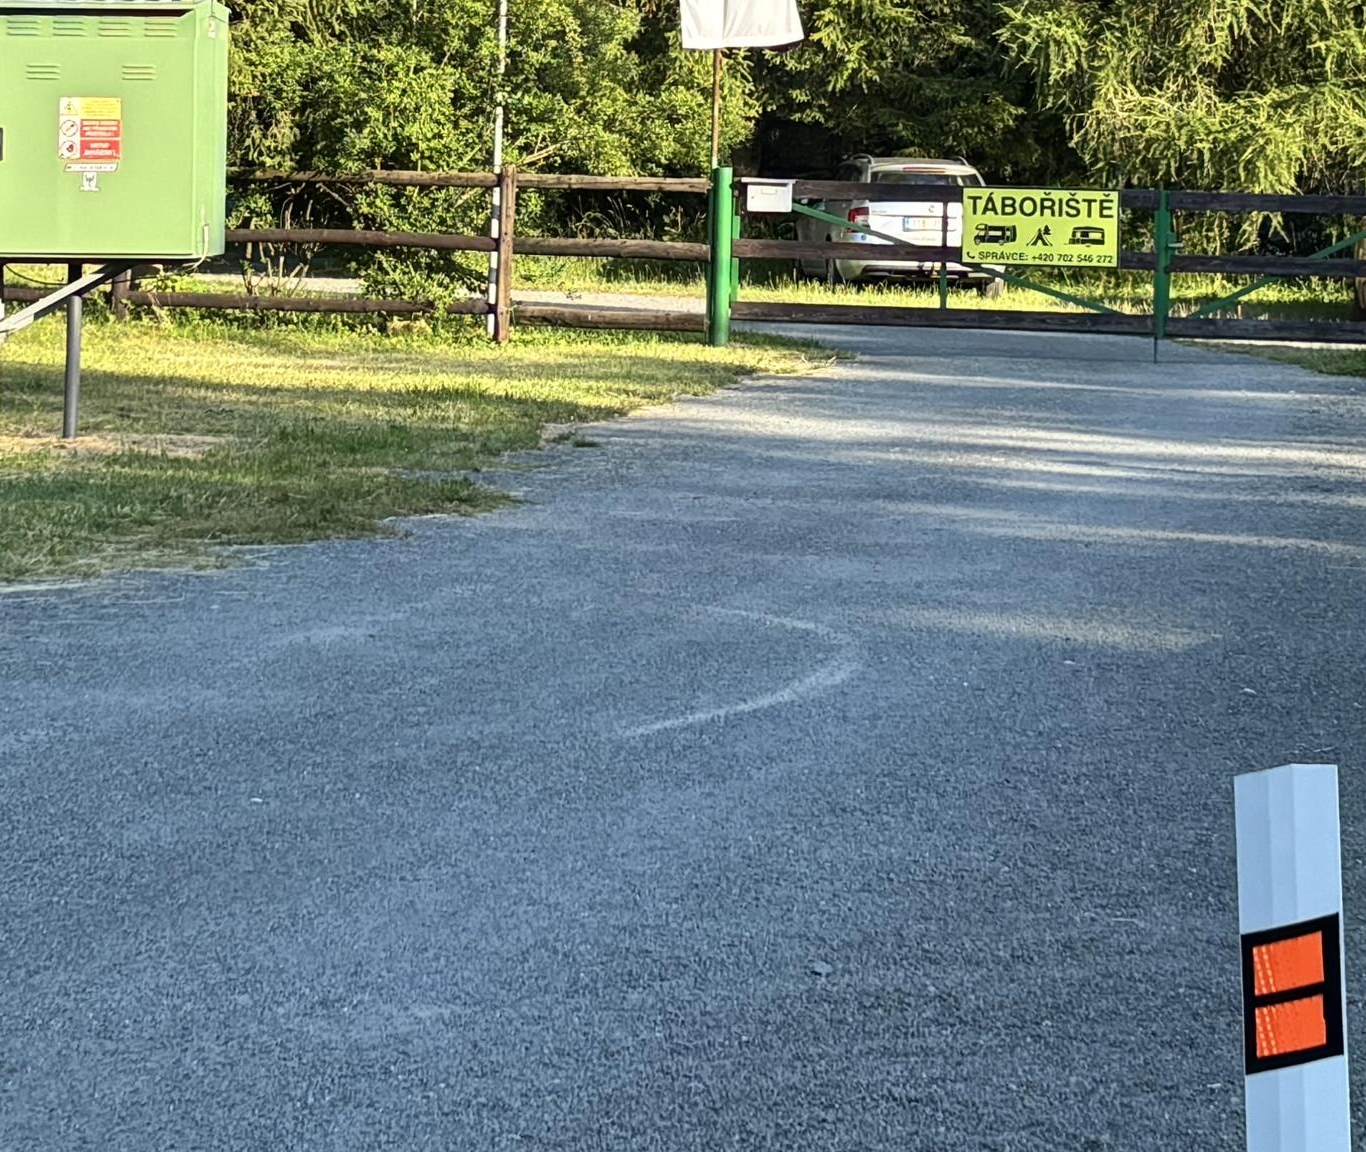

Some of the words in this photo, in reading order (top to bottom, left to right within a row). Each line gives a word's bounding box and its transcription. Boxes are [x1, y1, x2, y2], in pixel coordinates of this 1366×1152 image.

[967, 190, 1114, 219] TÁBOŘIŠTĚ
[978, 250, 1029, 261] SPRÁVCE:
[1031, 252, 1054, 262] +420
[1057, 252, 1074, 263] 702
[1096, 254, 1114, 264] 272
